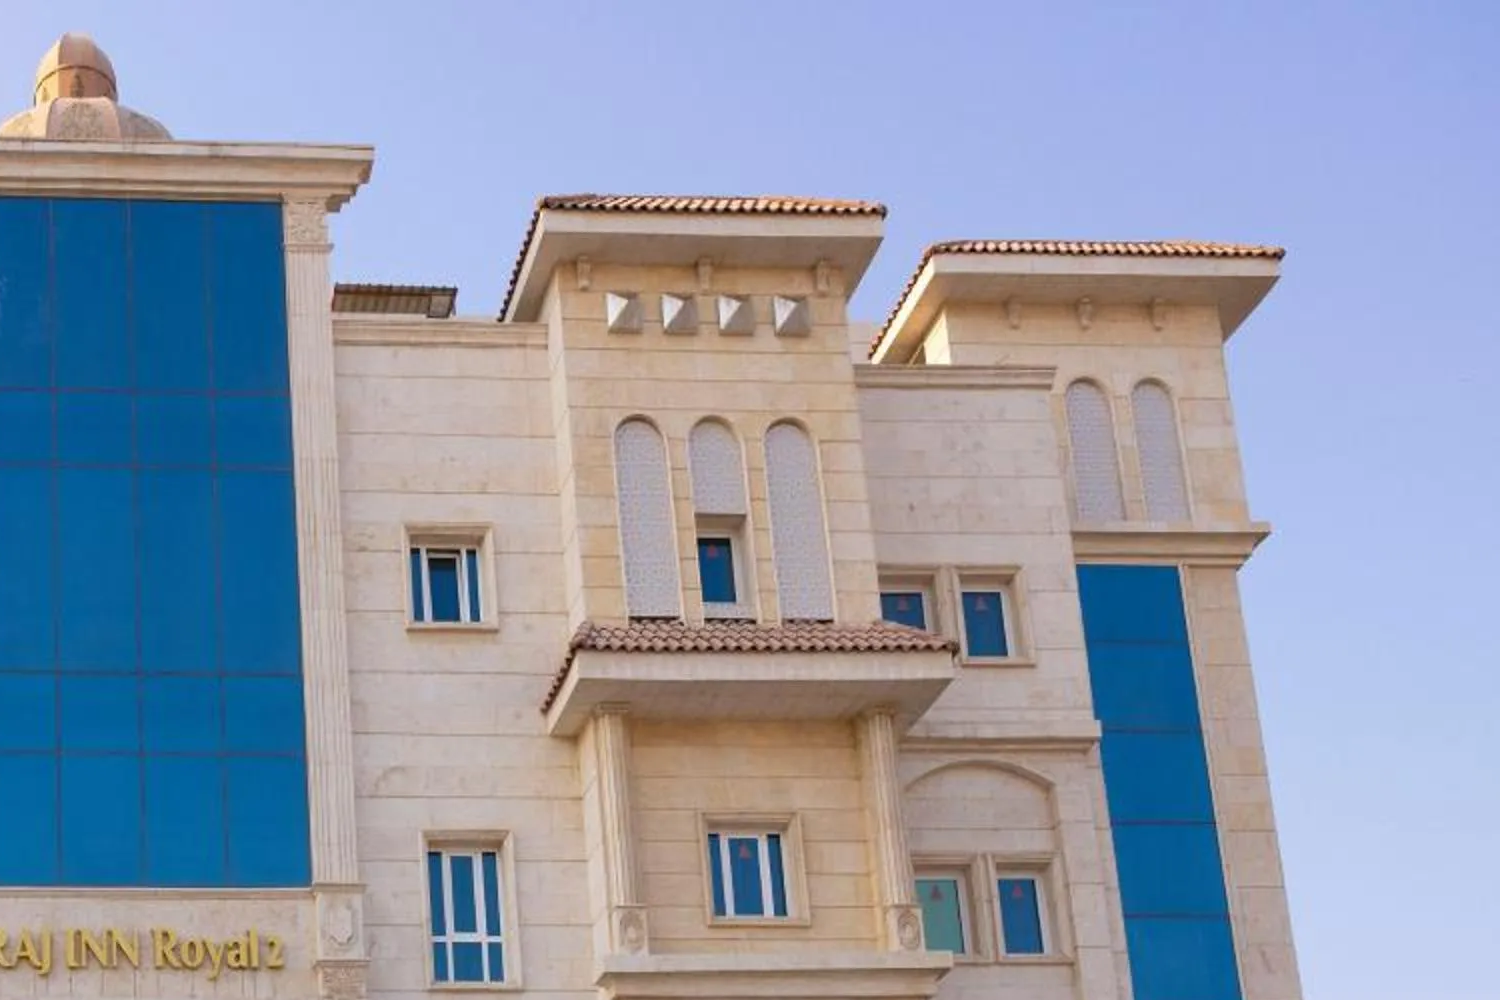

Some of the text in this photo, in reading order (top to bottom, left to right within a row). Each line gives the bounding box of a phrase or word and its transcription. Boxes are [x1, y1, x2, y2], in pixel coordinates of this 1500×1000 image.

[66, 926, 139, 969] INN
[152, 924, 260, 981] Royal
[266, 934, 285, 969] 2
